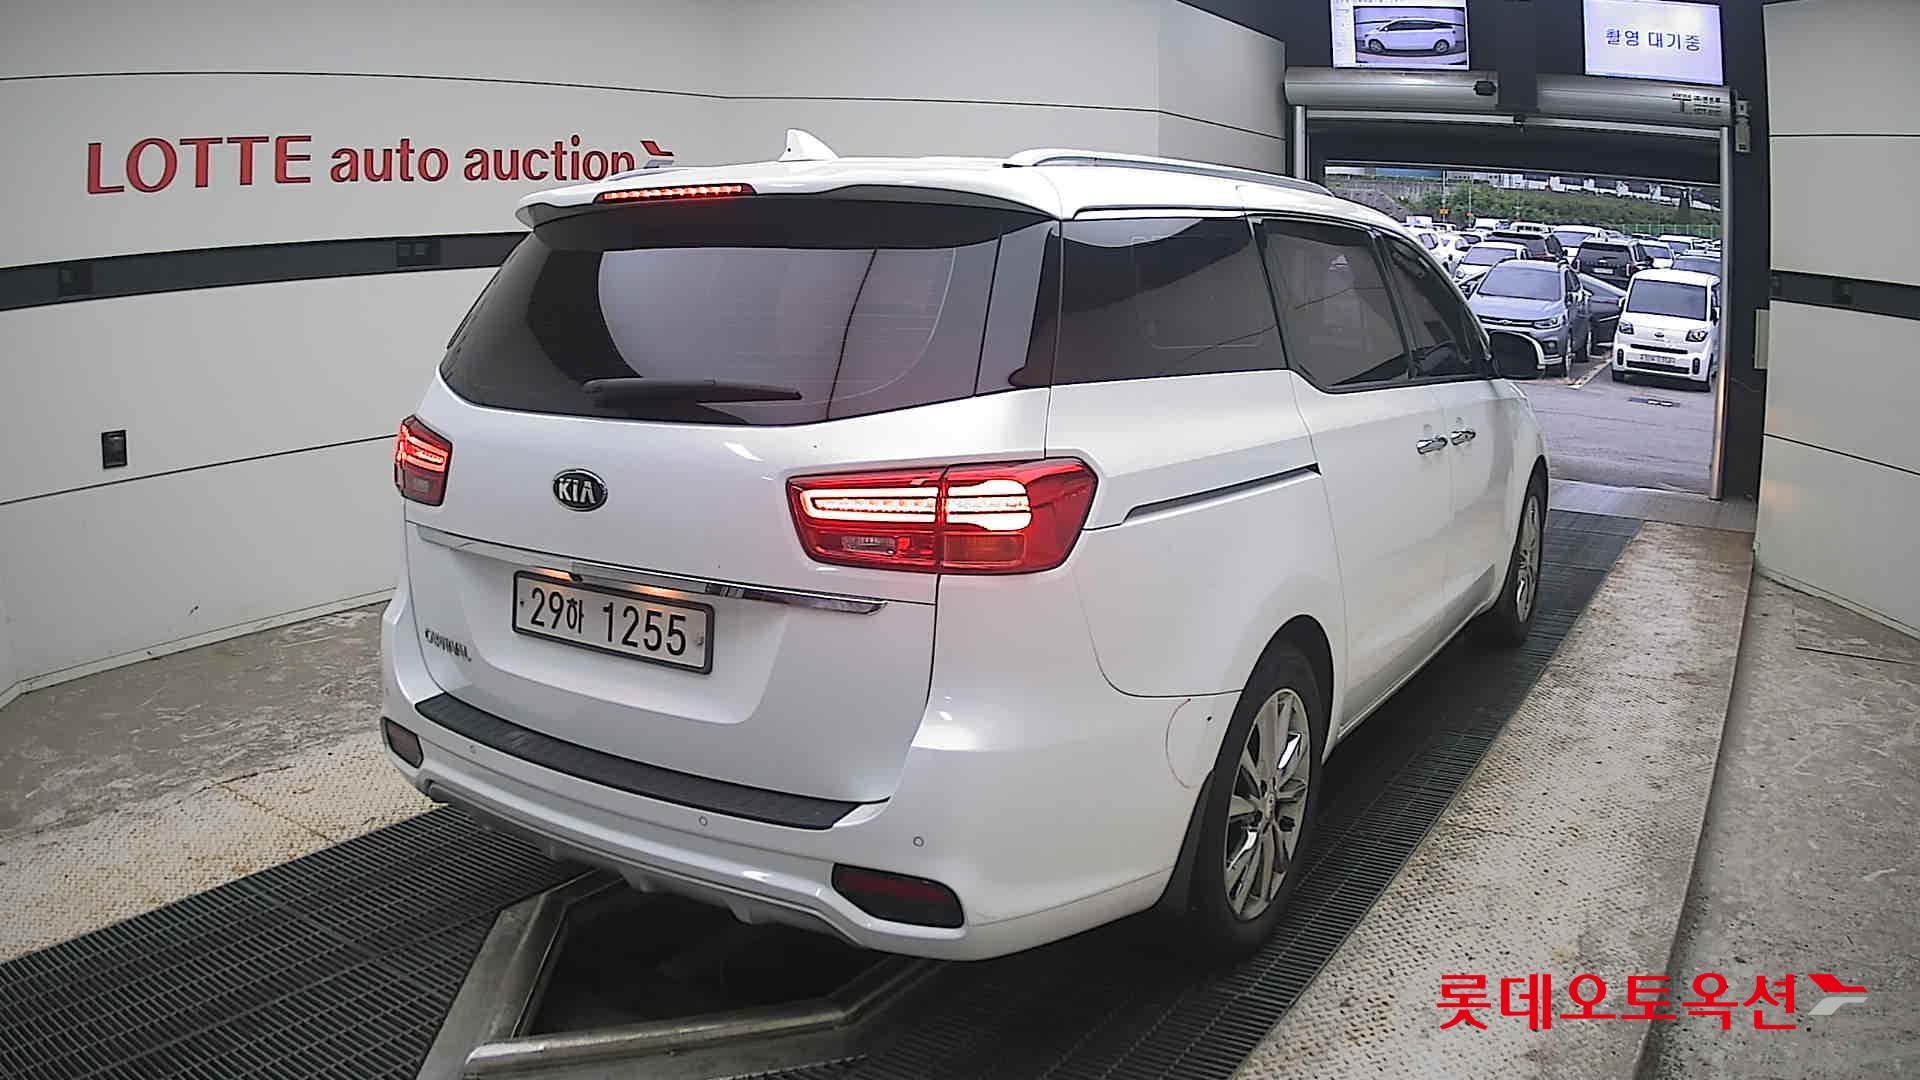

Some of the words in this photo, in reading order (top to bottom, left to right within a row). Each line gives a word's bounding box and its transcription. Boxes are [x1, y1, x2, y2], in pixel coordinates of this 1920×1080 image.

[1648, 31, 1700, 52] 대기중
[88, 135, 312, 195] LOTTE
[330, 138, 449, 183] auto
[463, 135, 635, 182] auction
[557, 476, 597, 505] KIA
[530, 587, 585, 634] 29하
[602, 601, 688, 657] 1255
